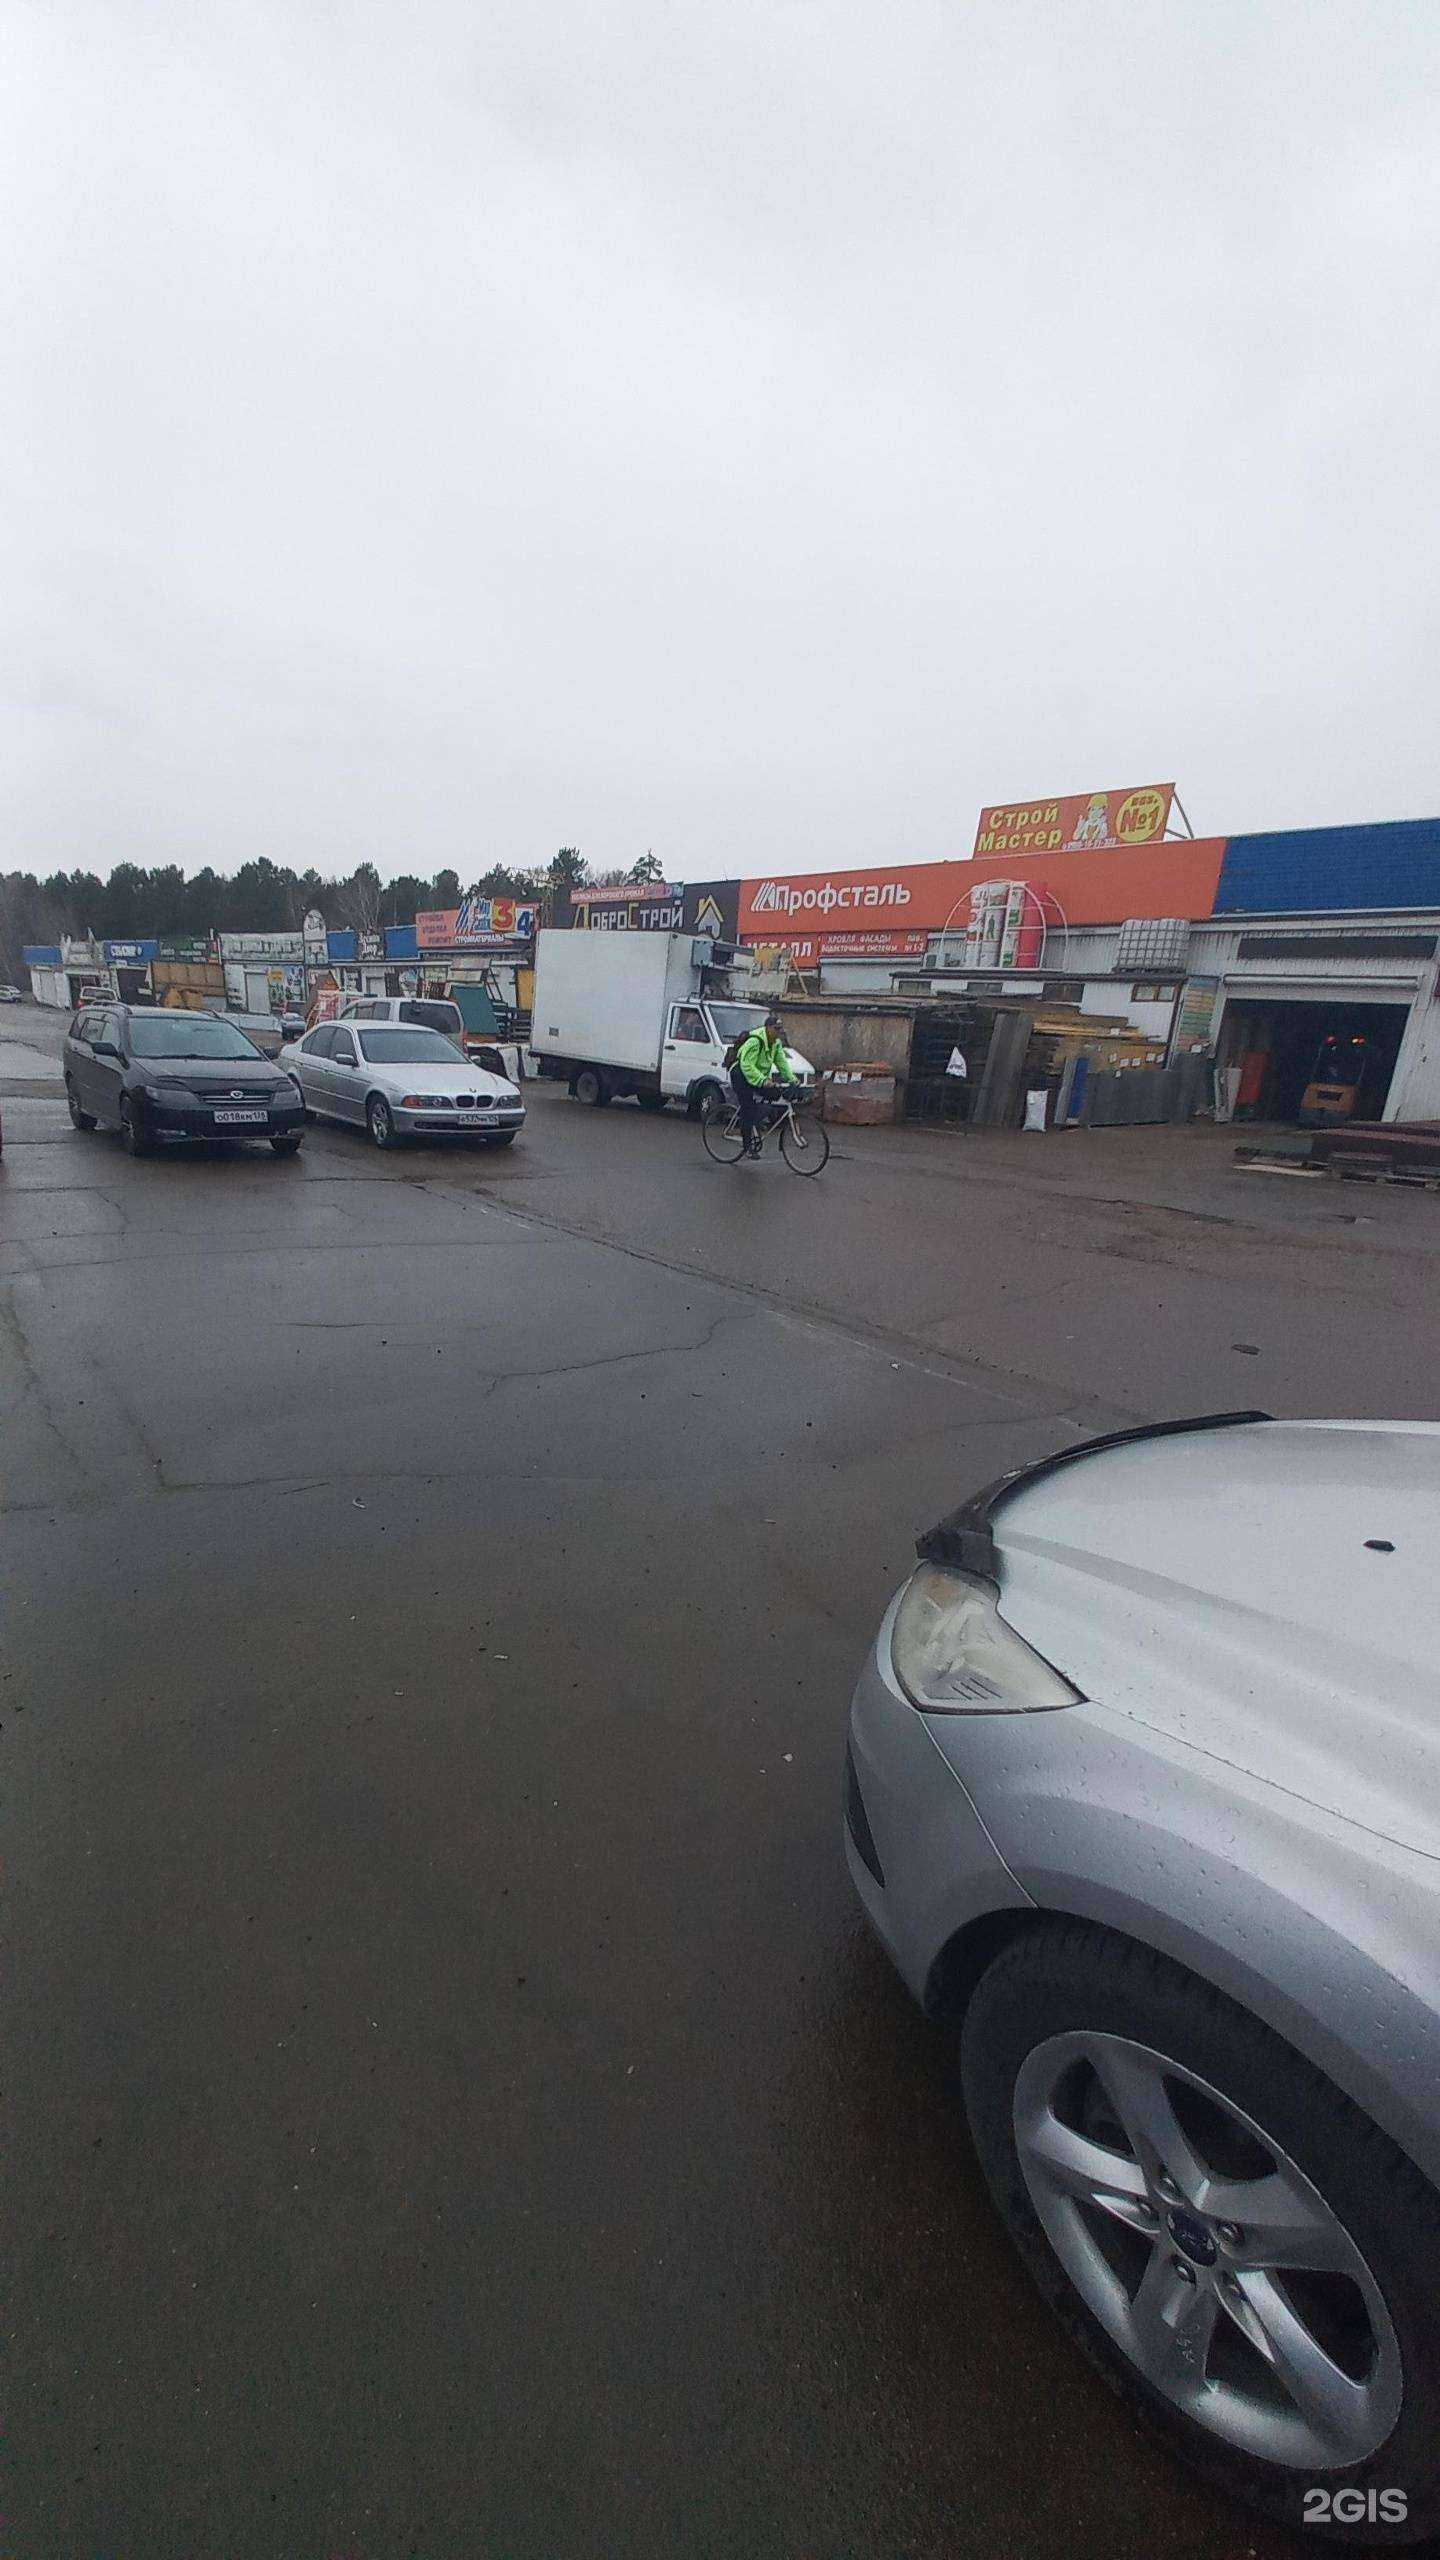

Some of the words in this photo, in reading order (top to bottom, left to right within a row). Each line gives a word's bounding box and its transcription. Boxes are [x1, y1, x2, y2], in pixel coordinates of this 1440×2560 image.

[989, 802, 1059, 832] Строй
[977, 828, 1063, 851] Мастер
[775, 882, 911, 916] Профсталь
